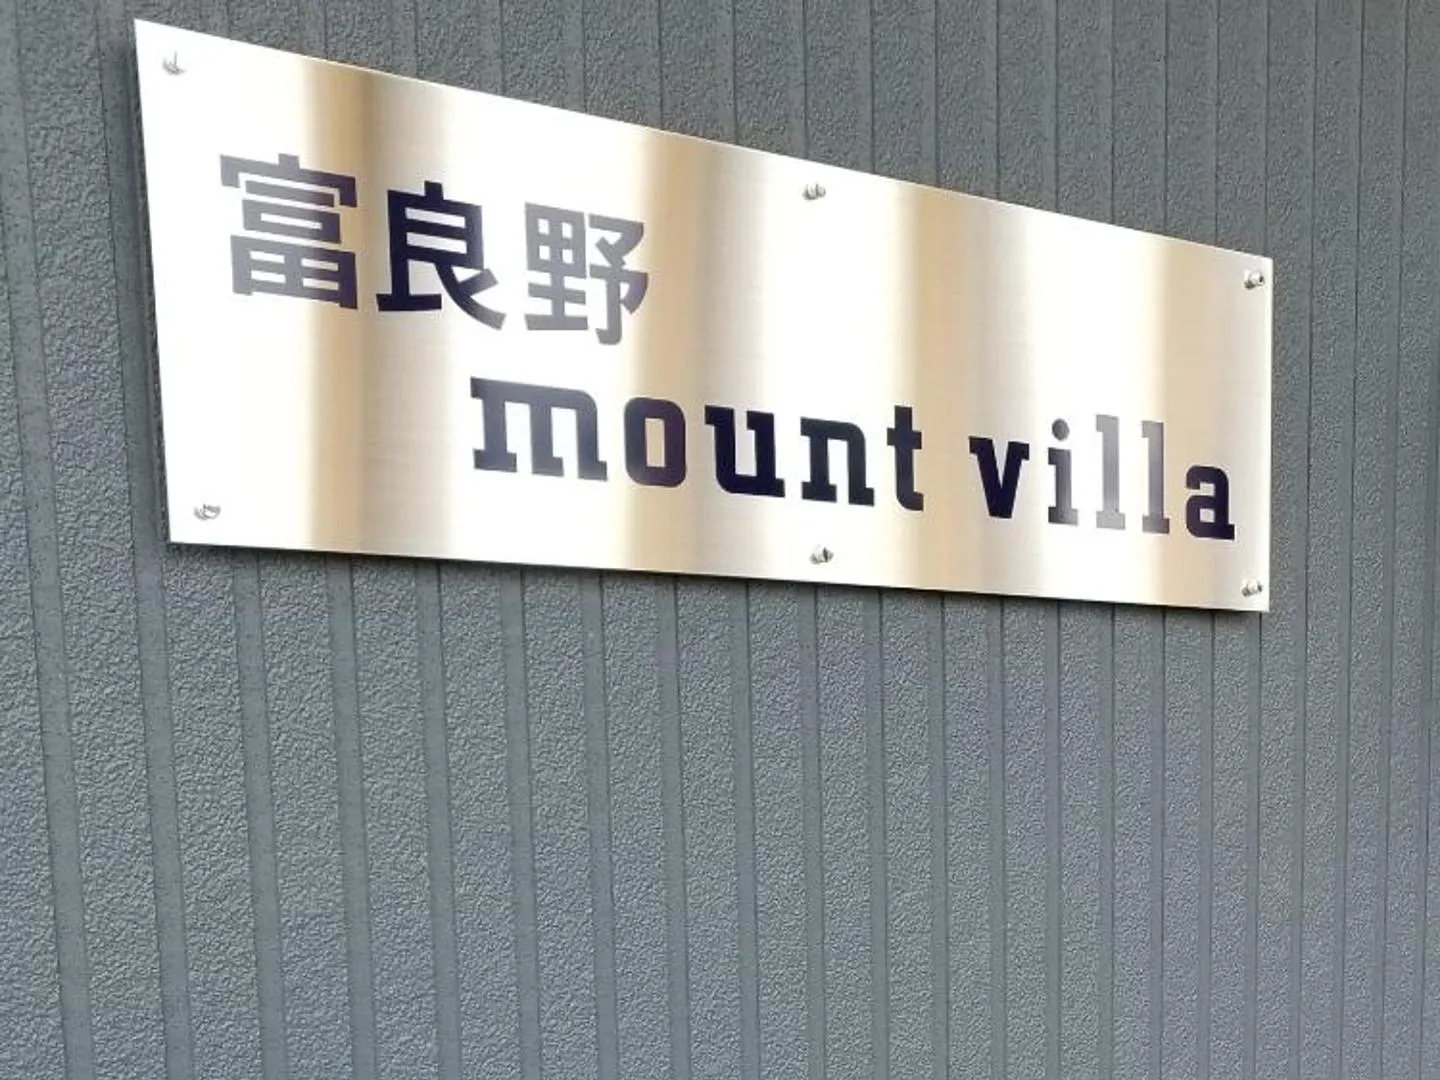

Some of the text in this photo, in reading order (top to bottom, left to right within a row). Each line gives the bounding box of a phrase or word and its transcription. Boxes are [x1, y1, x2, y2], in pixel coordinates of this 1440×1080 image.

[220, 154, 648, 345] 富良野
[470, 377, 1235, 541] mount villa
